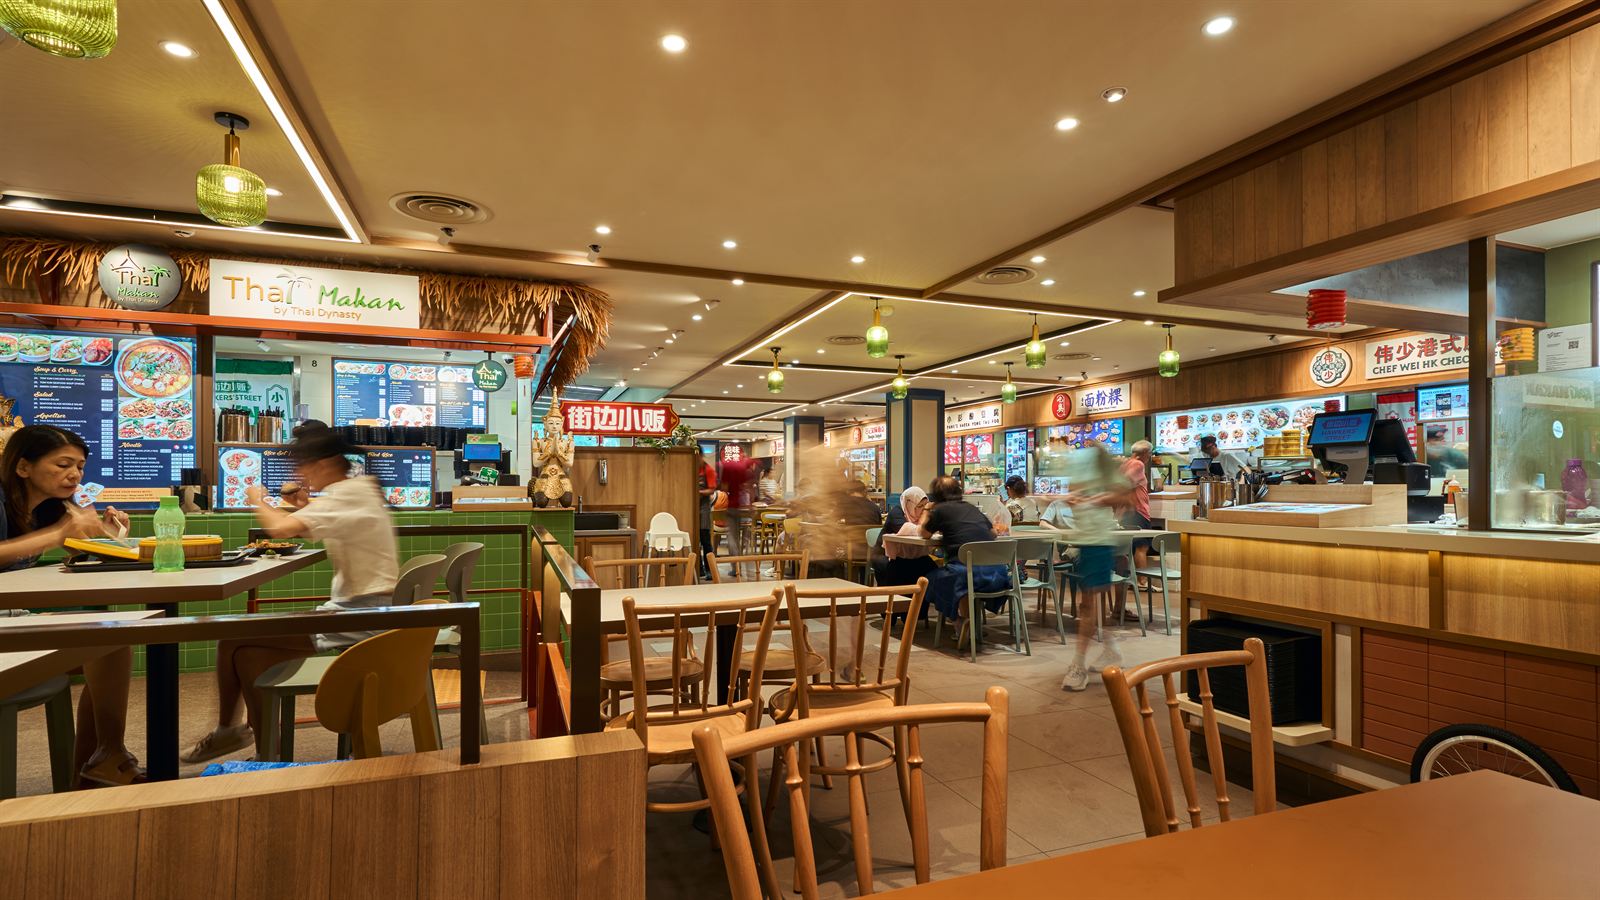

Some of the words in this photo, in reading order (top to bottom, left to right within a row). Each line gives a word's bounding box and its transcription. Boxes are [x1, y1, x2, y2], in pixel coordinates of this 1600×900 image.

[116, 268, 166, 287] Thai
[117, 287, 159, 298] Makan
[222, 271, 311, 304] Thai
[318, 285, 405, 311] Makan
[273, 305, 287, 316] by
[291, 306, 315, 316] Thai
[317, 308, 362, 321] Dynasty
[1374, 335, 1469, 364] 伟少港式
[311, 359, 317, 367] 8
[1372, 364, 1397, 374] CHEF
[1400, 362, 1419, 371] WEI
[1423, 358, 1438, 368] HK
[235, 394, 262, 402] STREET
[271, 392, 284, 403] 小
[1084, 387, 1123, 407] 面粉粿
[567, 405, 666, 432] 街边小贩
